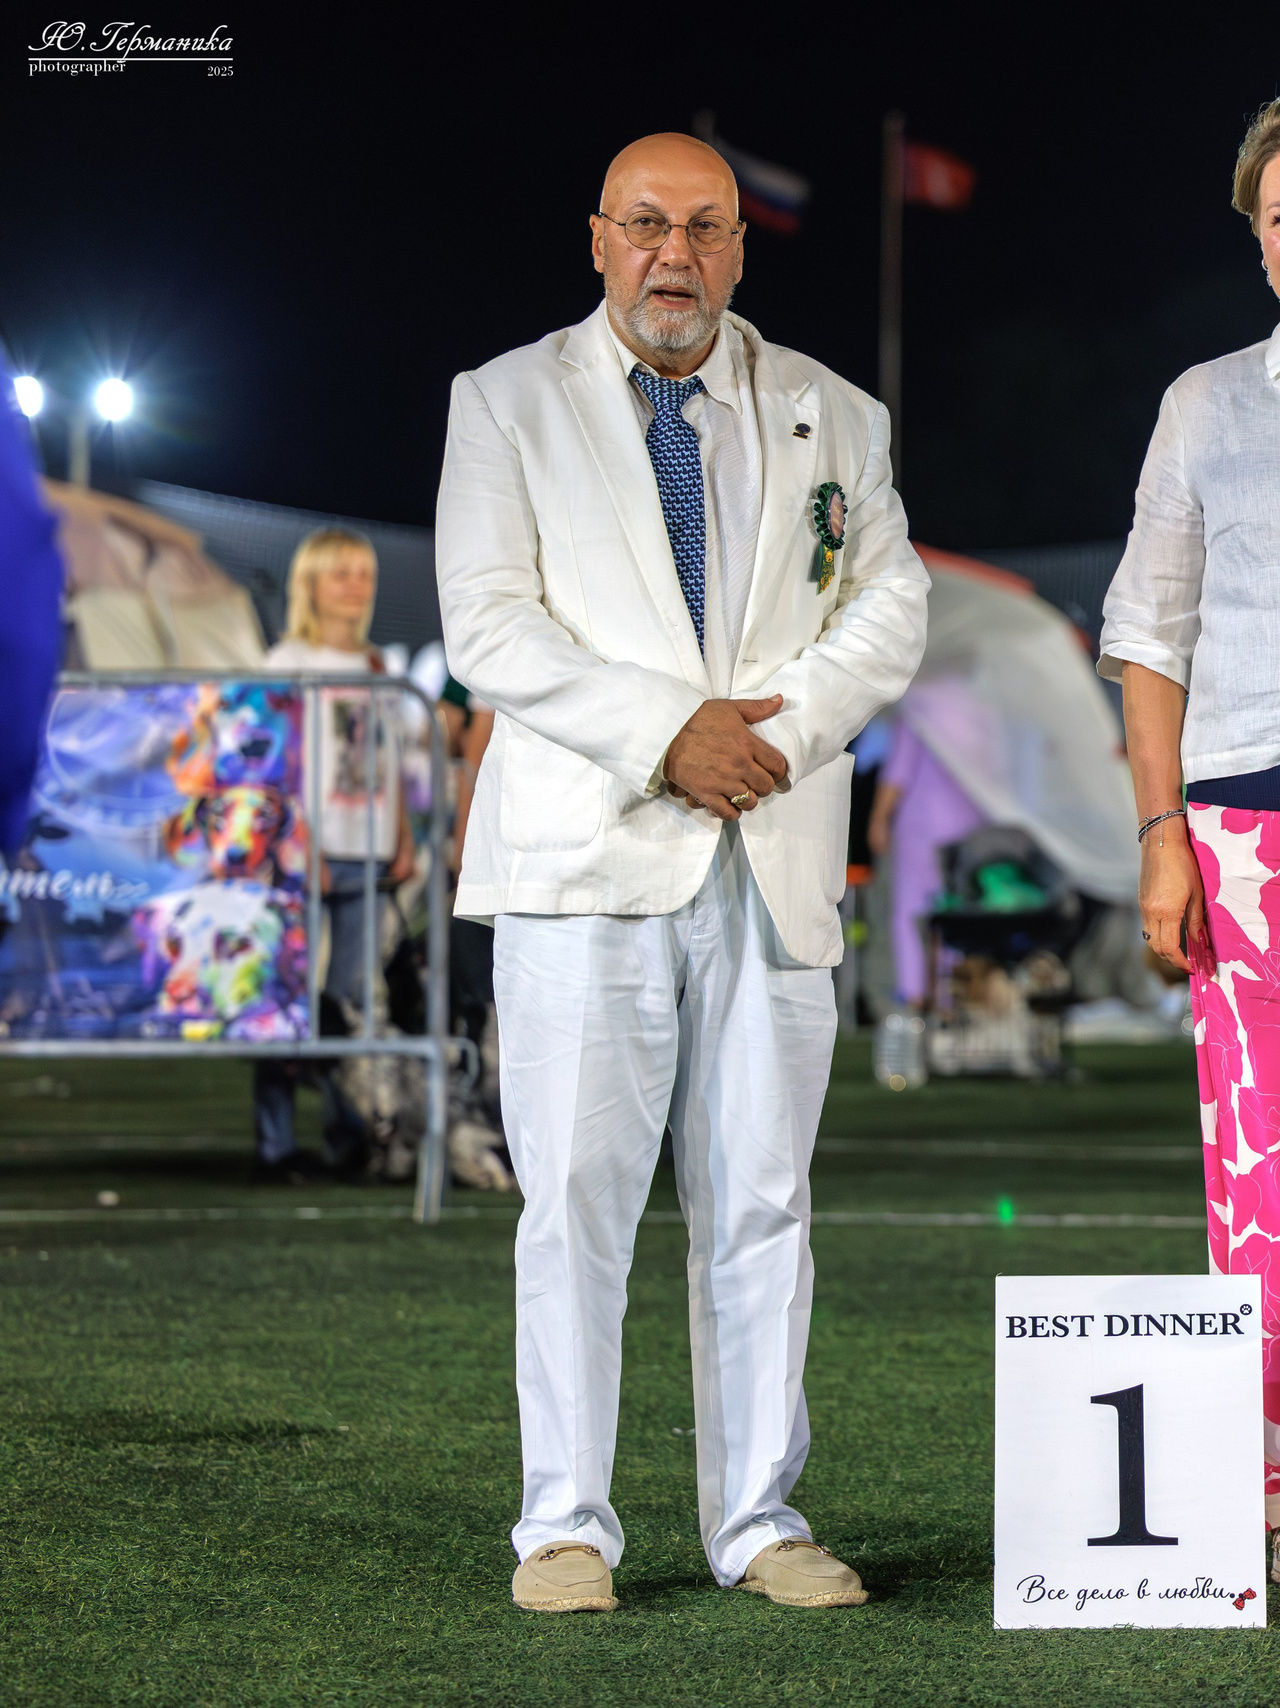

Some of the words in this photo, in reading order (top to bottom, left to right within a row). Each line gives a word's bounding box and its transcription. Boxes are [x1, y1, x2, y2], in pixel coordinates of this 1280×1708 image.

[1005, 1314, 1095, 1338] BEST
[1103, 1312, 1244, 1337] DINNER
[1087, 1383, 1179, 1547] 1
[1016, 1574, 1069, 1604] Все
[1075, 1588, 1130, 1611] дело
[1136, 1578, 1151, 1599] в
